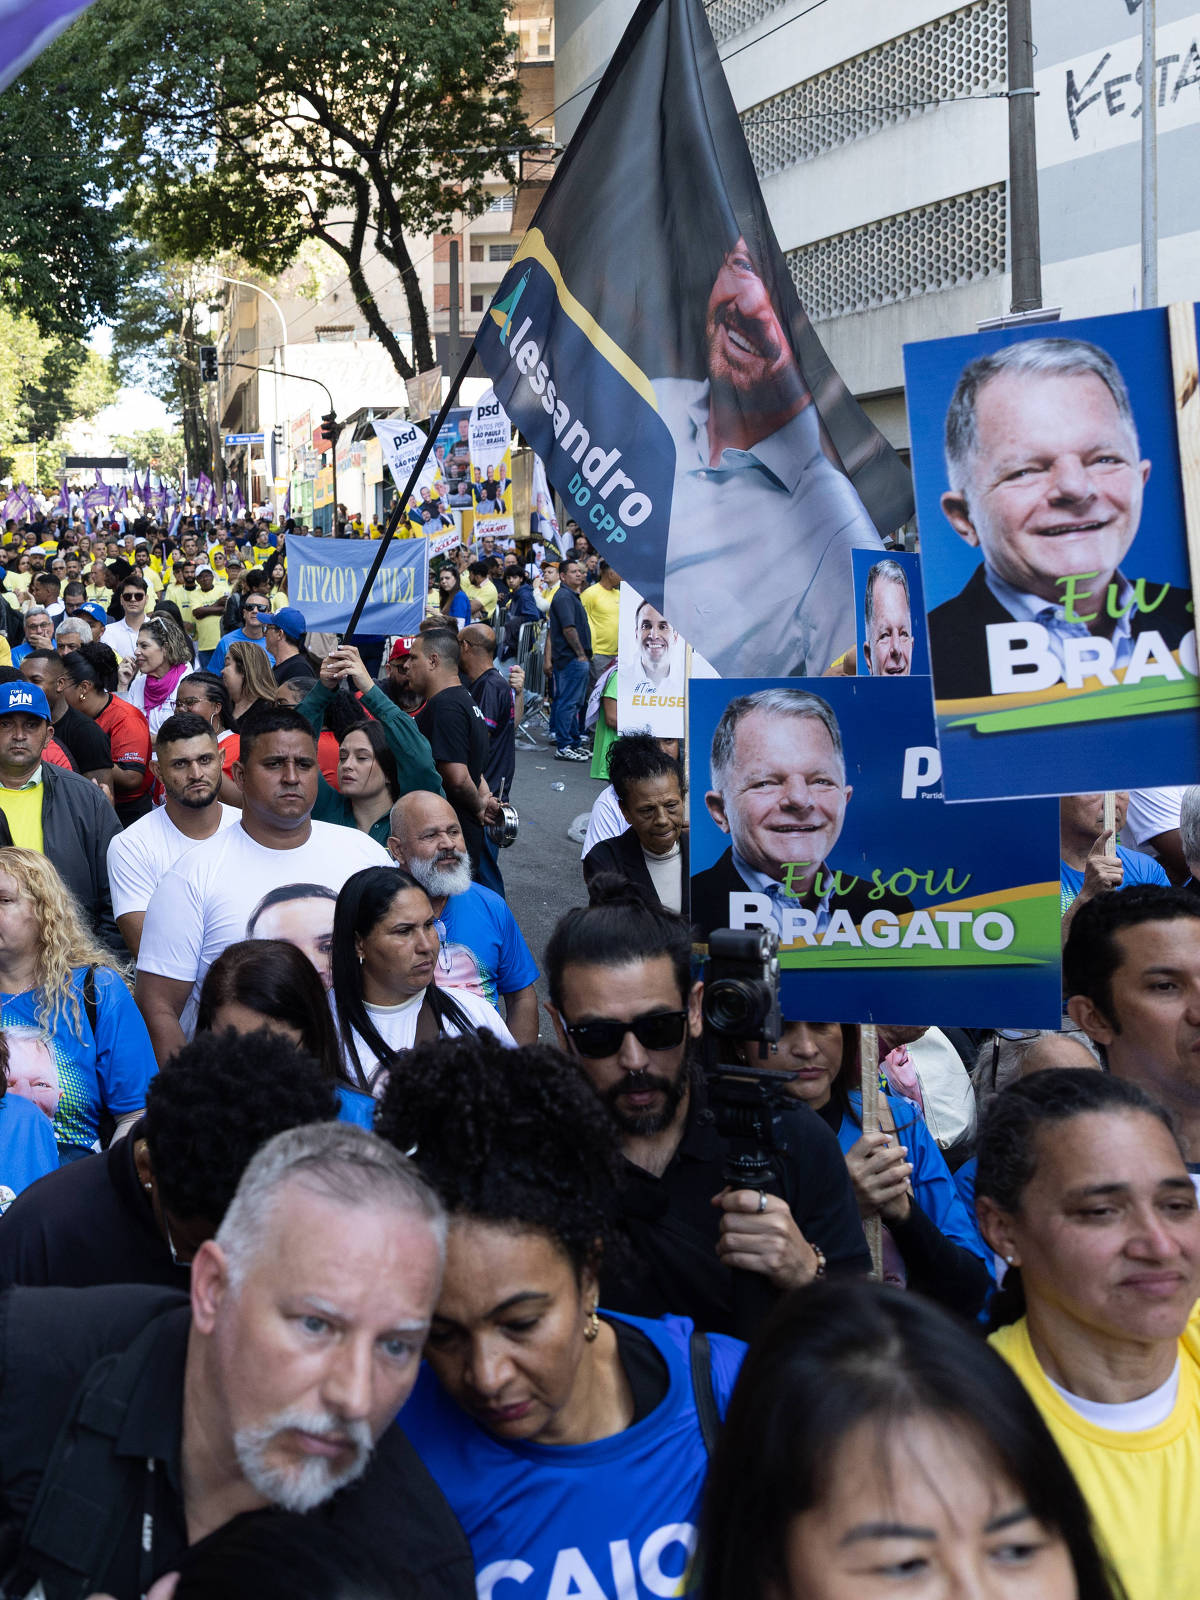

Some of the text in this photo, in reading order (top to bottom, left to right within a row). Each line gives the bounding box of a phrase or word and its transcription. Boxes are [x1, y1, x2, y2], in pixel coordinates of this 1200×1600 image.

[477, 401, 500, 421] psd
[393, 427, 418, 450] psd
[568, 472, 627, 543] DO CPP
[1055, 571, 1170, 624] Eu
[9, 693, 33, 704] MN
[780, 861, 971, 900] Eu sou
[729, 891, 1015, 951] BRAGATO
